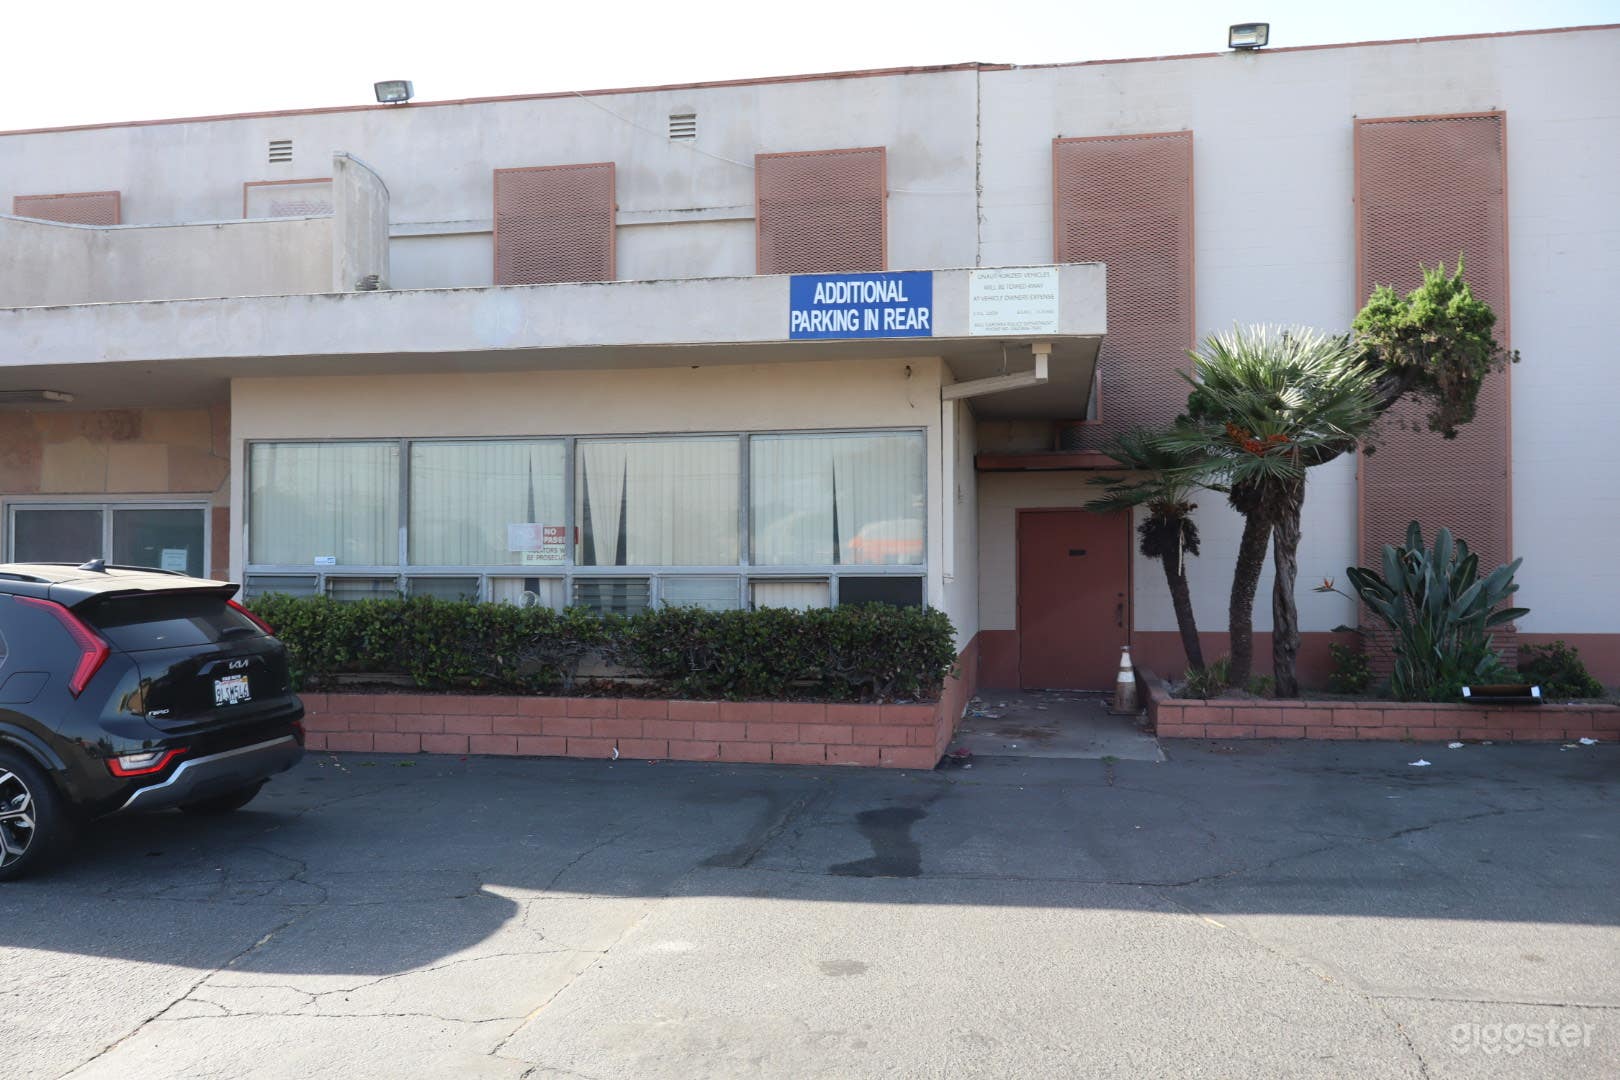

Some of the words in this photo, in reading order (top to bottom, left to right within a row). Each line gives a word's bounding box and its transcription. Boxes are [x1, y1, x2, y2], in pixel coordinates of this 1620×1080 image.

[813, 280, 908, 304] ADDITIONAL
[792, 309, 859, 332] PARKING
[864, 309, 879, 331] IN
[884, 307, 930, 330] REAR
[229, 659, 249, 669] KIA
